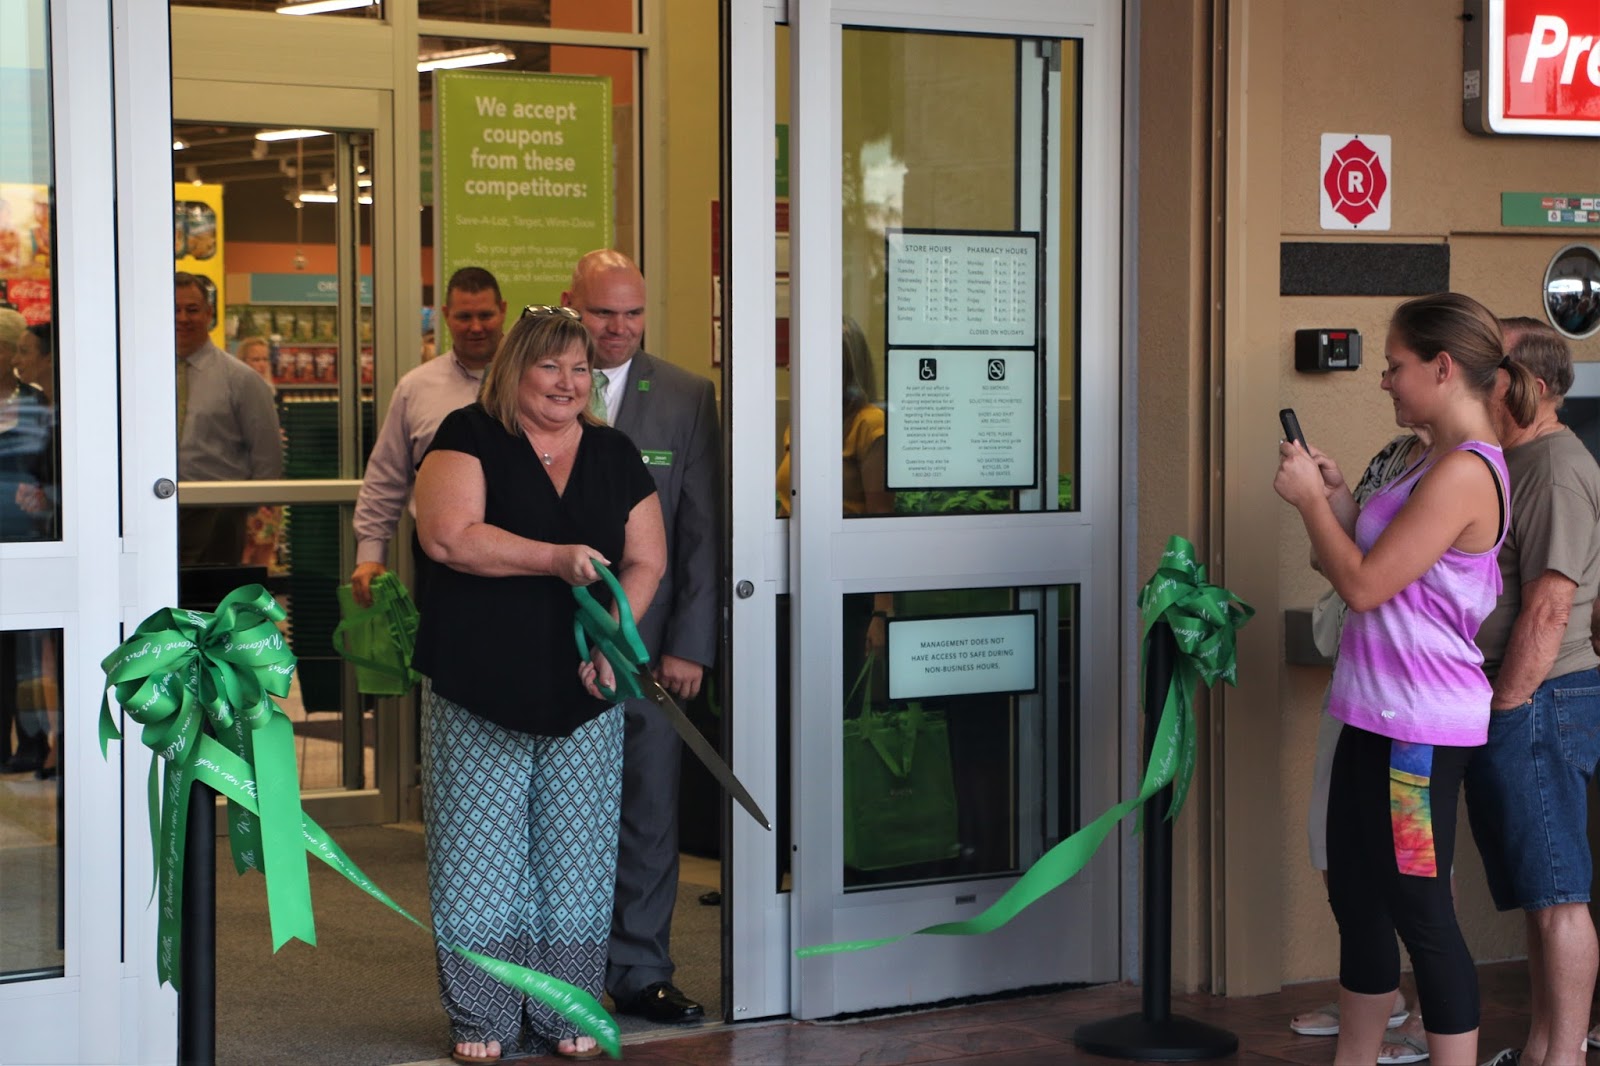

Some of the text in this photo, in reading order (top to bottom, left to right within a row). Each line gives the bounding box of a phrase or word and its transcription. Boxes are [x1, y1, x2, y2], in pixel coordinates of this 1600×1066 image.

[475, 96, 577, 126] We accept
[482, 128, 564, 150] coupons
[470, 147, 576, 172] from these
[464, 176, 587, 201] competitors:
[1347, 170, 1365, 194] R
[905, 245, 952, 254] STORE HOURS
[967, 246, 1028, 256] PHARMACY HOURS
[235, 633, 283, 656] Welcome
[920, 637, 1005, 649] MANAGEMENT DOES NOT
[911, 649, 1014, 662] HAVE ACCESS TO SAFE DURING
[924, 664, 975, 674] NON-BUSINESS
[194, 757, 240, 786] your new
